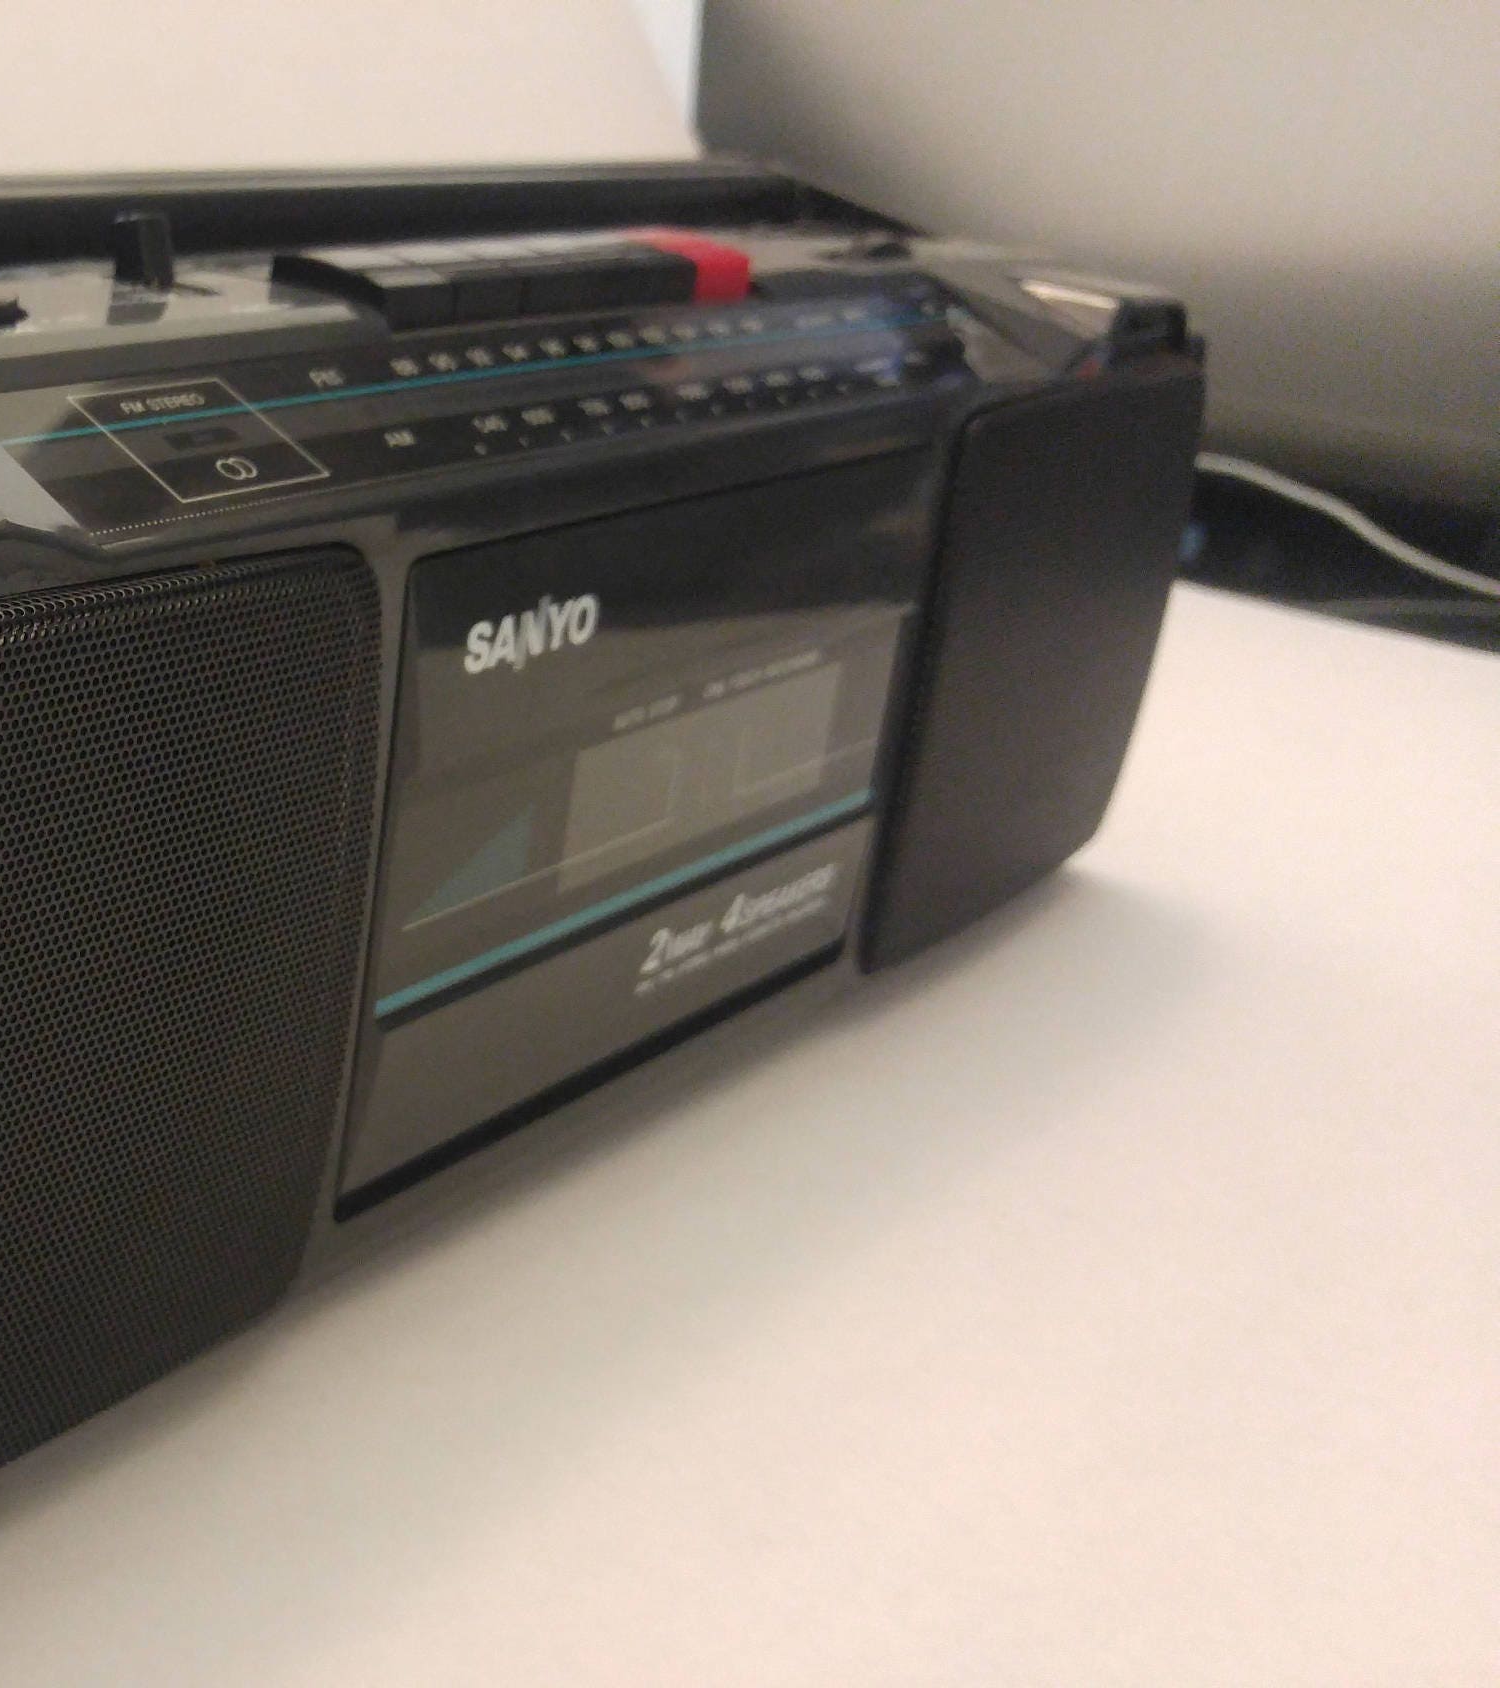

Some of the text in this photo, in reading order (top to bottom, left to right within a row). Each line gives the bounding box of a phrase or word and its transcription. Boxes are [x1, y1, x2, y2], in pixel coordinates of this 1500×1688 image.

[119, 392, 206, 415] FM STEREO
[384, 430, 416, 448] AM
[464, 594, 598, 674] SANYO
